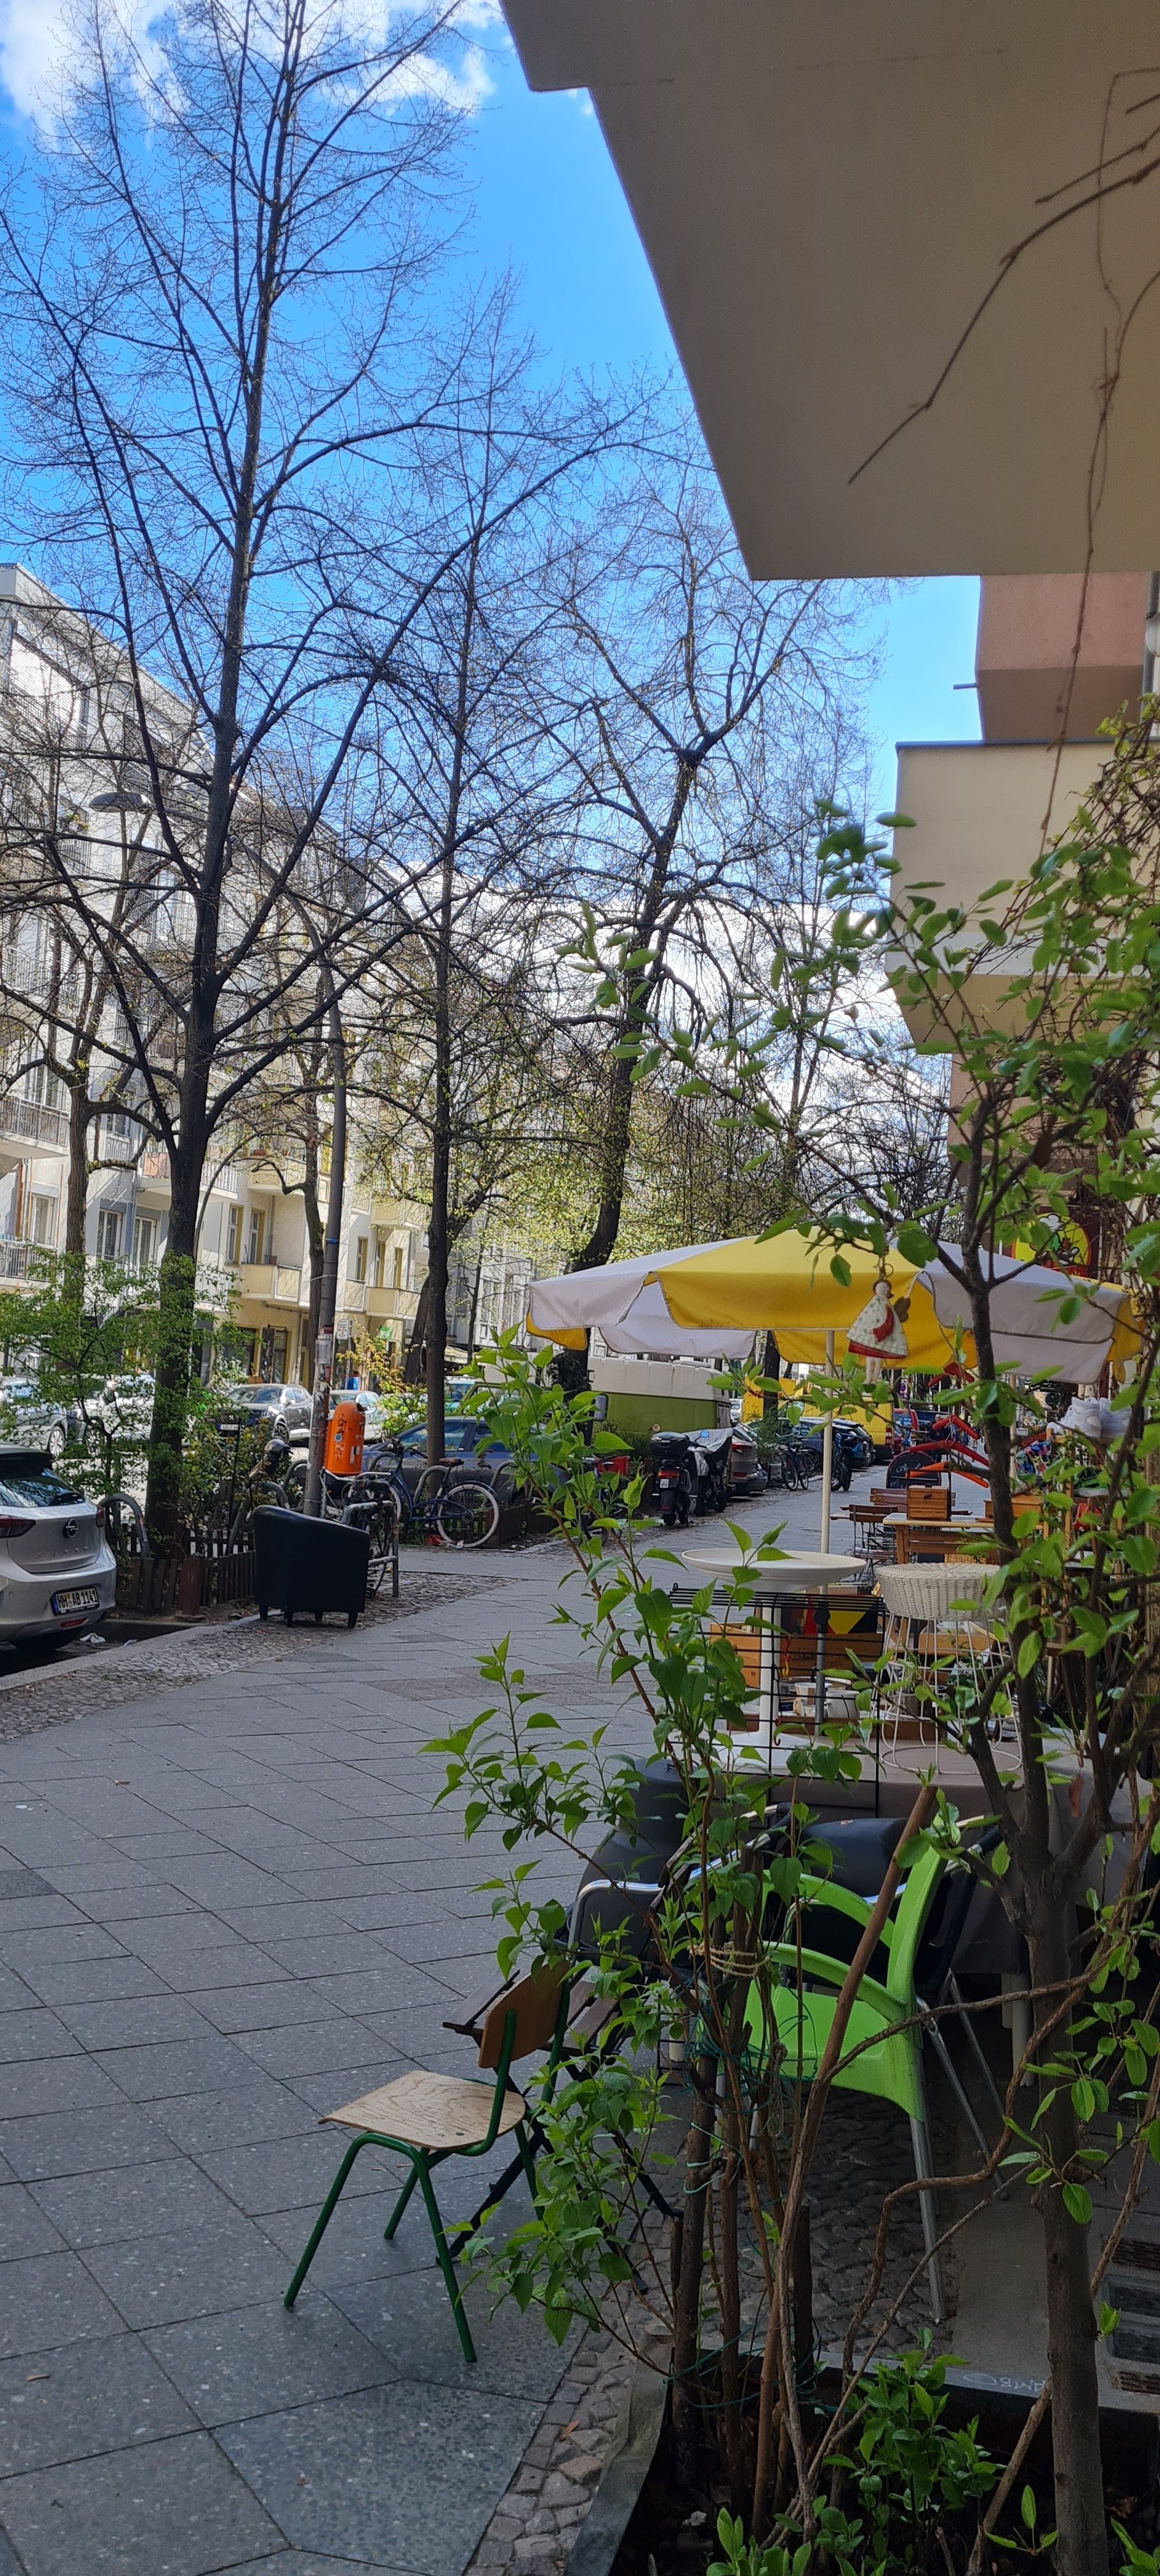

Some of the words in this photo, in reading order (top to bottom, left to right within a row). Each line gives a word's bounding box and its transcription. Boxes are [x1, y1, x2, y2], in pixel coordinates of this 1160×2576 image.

[57, 1594, 68, 1608] HH
[72, 1592, 81, 1606] AB
[81, 1590, 98, 1604] 1141
